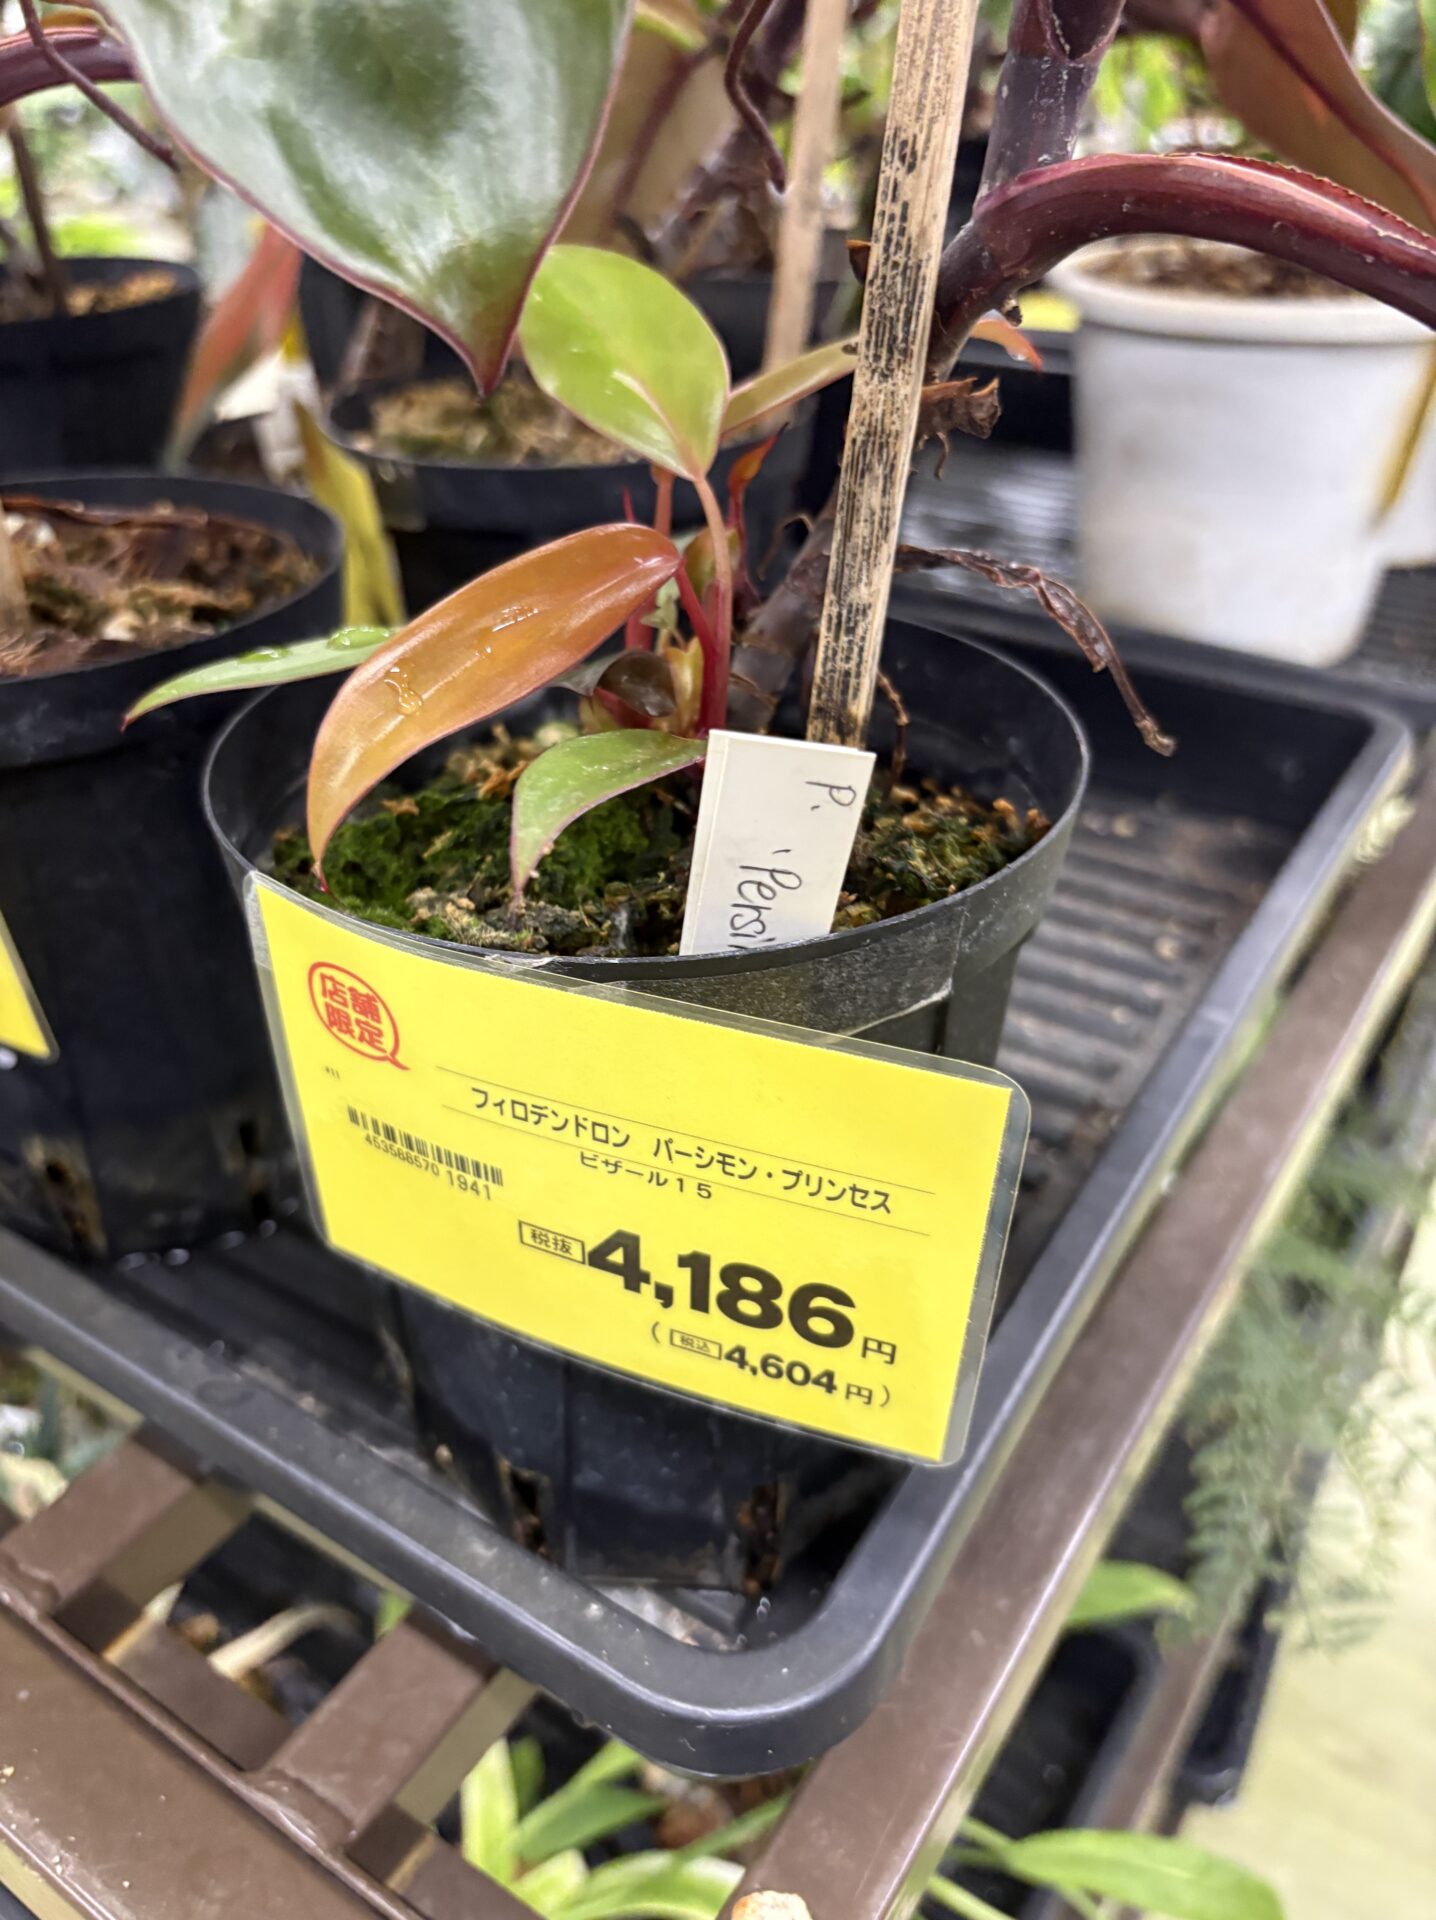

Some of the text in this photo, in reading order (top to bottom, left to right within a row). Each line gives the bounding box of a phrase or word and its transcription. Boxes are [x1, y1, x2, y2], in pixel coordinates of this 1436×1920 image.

[318, 971, 383, 1025] 店舗
[323, 1000, 388, 1054] 限定
[471, 1086, 891, 1215] フィロデンドロン パーシモン・プリンセス
